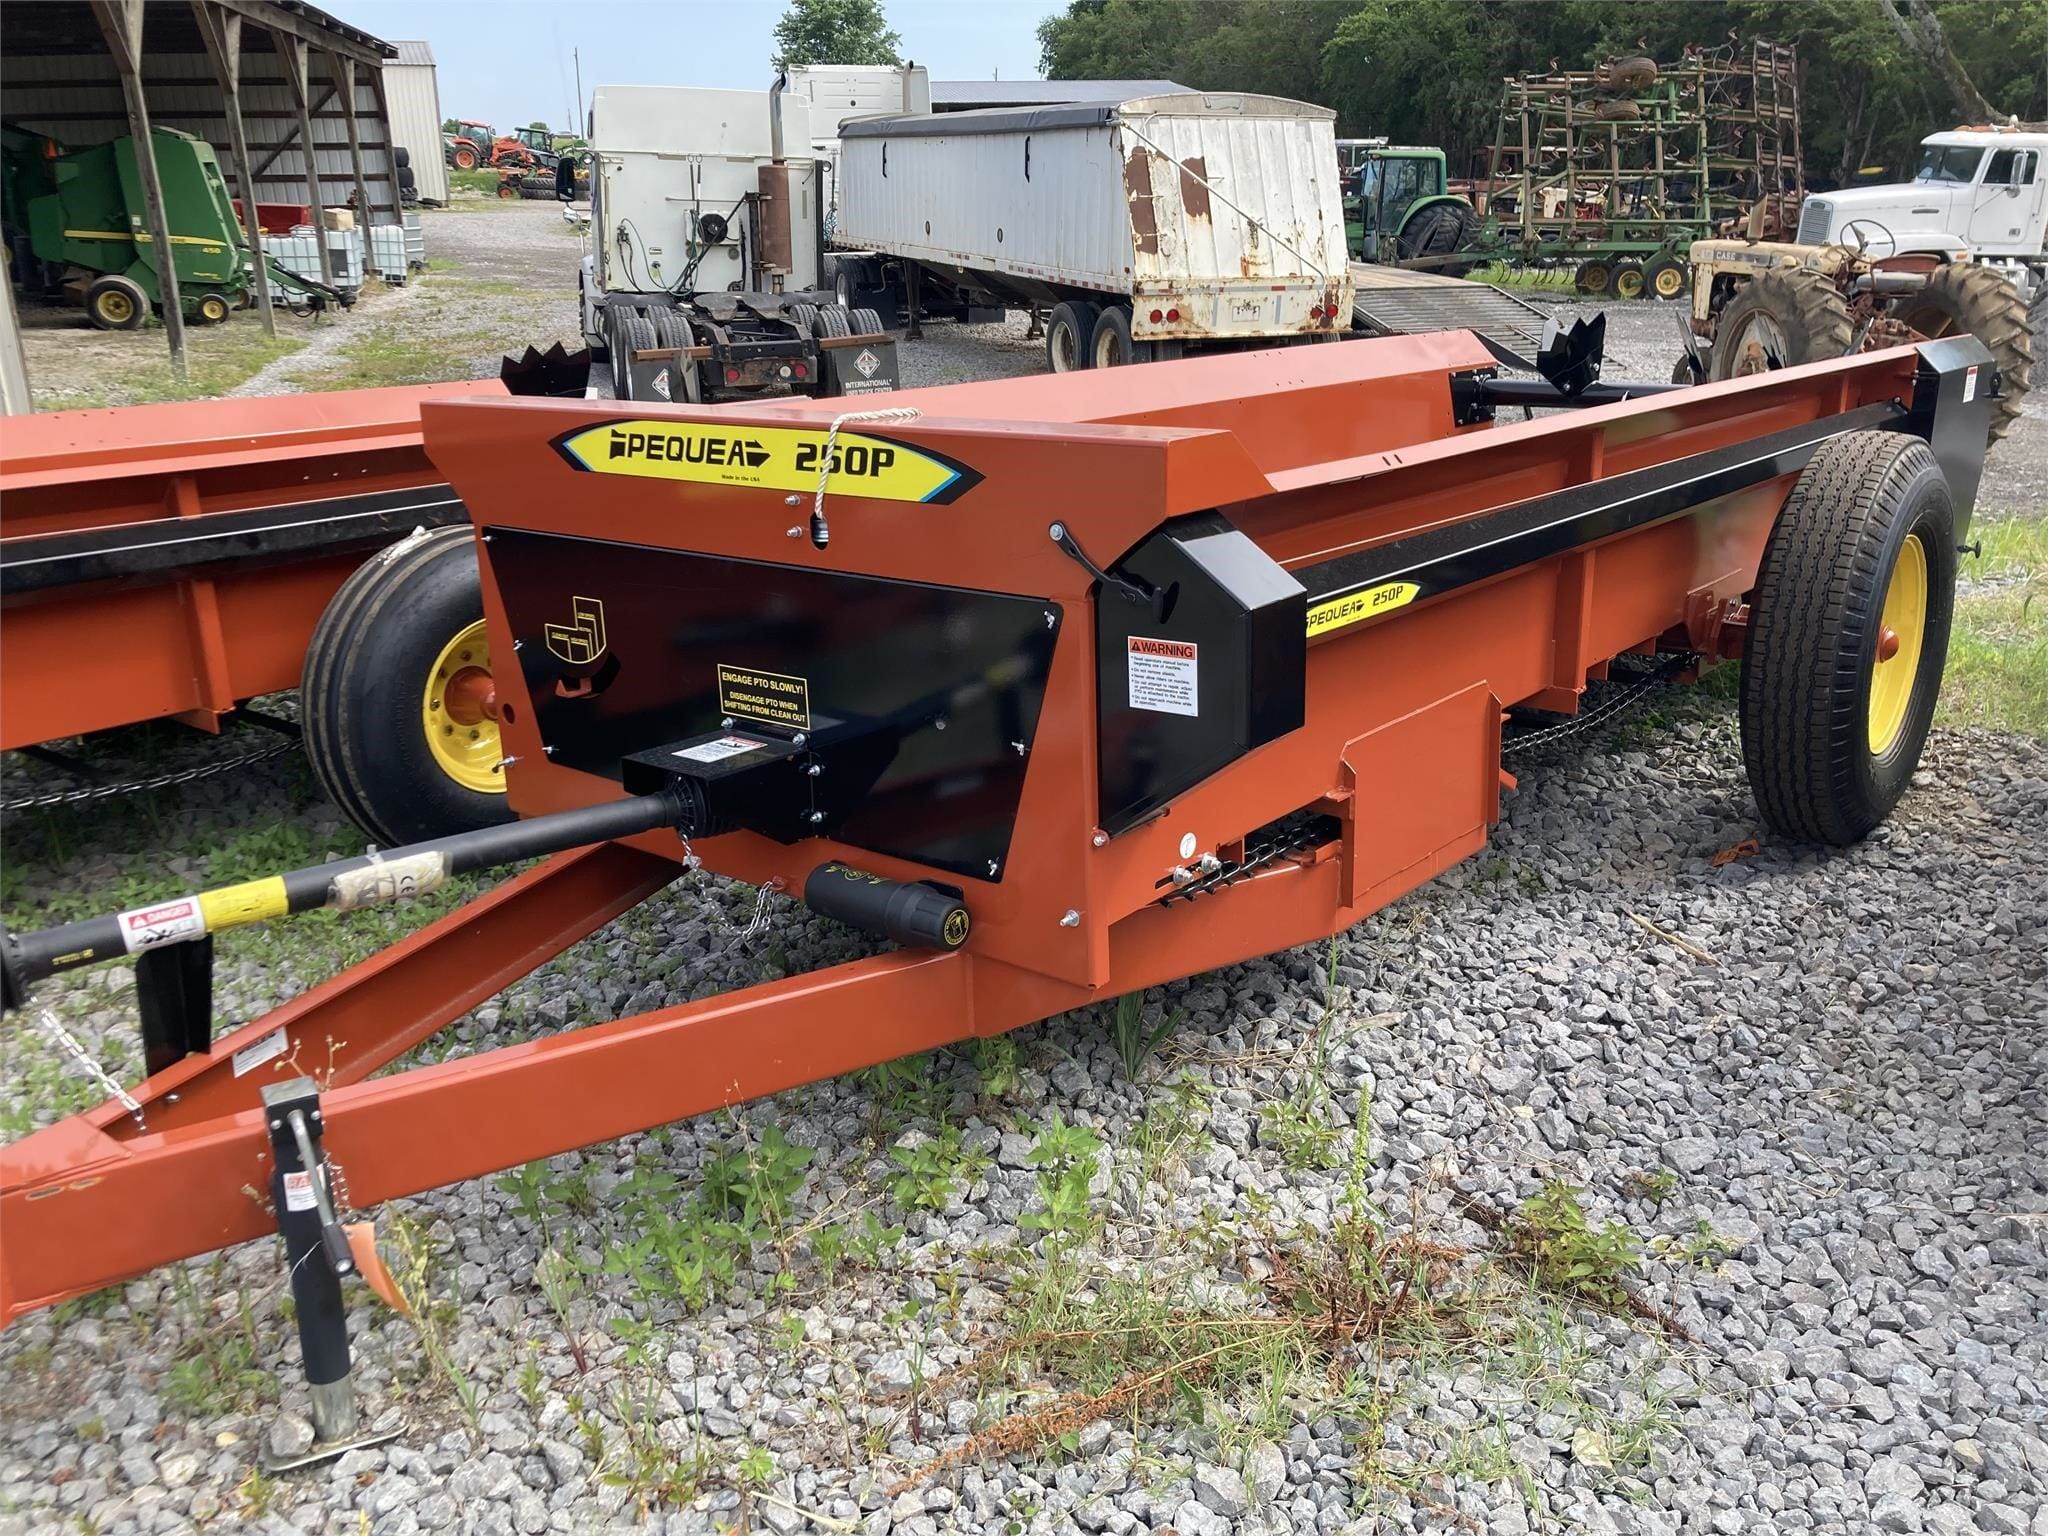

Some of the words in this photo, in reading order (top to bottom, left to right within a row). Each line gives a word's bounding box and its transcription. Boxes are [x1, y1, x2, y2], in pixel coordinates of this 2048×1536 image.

[1716, 251, 1736, 260] CASE
[627, 433, 746, 466] PEQUEA
[796, 442, 894, 477] 250P
[1309, 602, 1356, 628] PEQUEA
[1373, 585, 1404, 606] 250P
[1141, 641, 1192, 658] WARNING
[722, 672, 752, 686] ENGAGE
[754, 678, 769, 688] PTO
[770, 680, 803, 695] SLOWLY!
[724, 700, 751, 711] SHIFTING
[752, 705, 769, 715] FROM
[770, 709, 791, 720] CLEAN
[792, 714, 805, 722] OUT
[730, 691, 764, 704] DISENGAGE
[766, 698, 778, 707] PTO
[779, 700, 798, 710] WHEN
